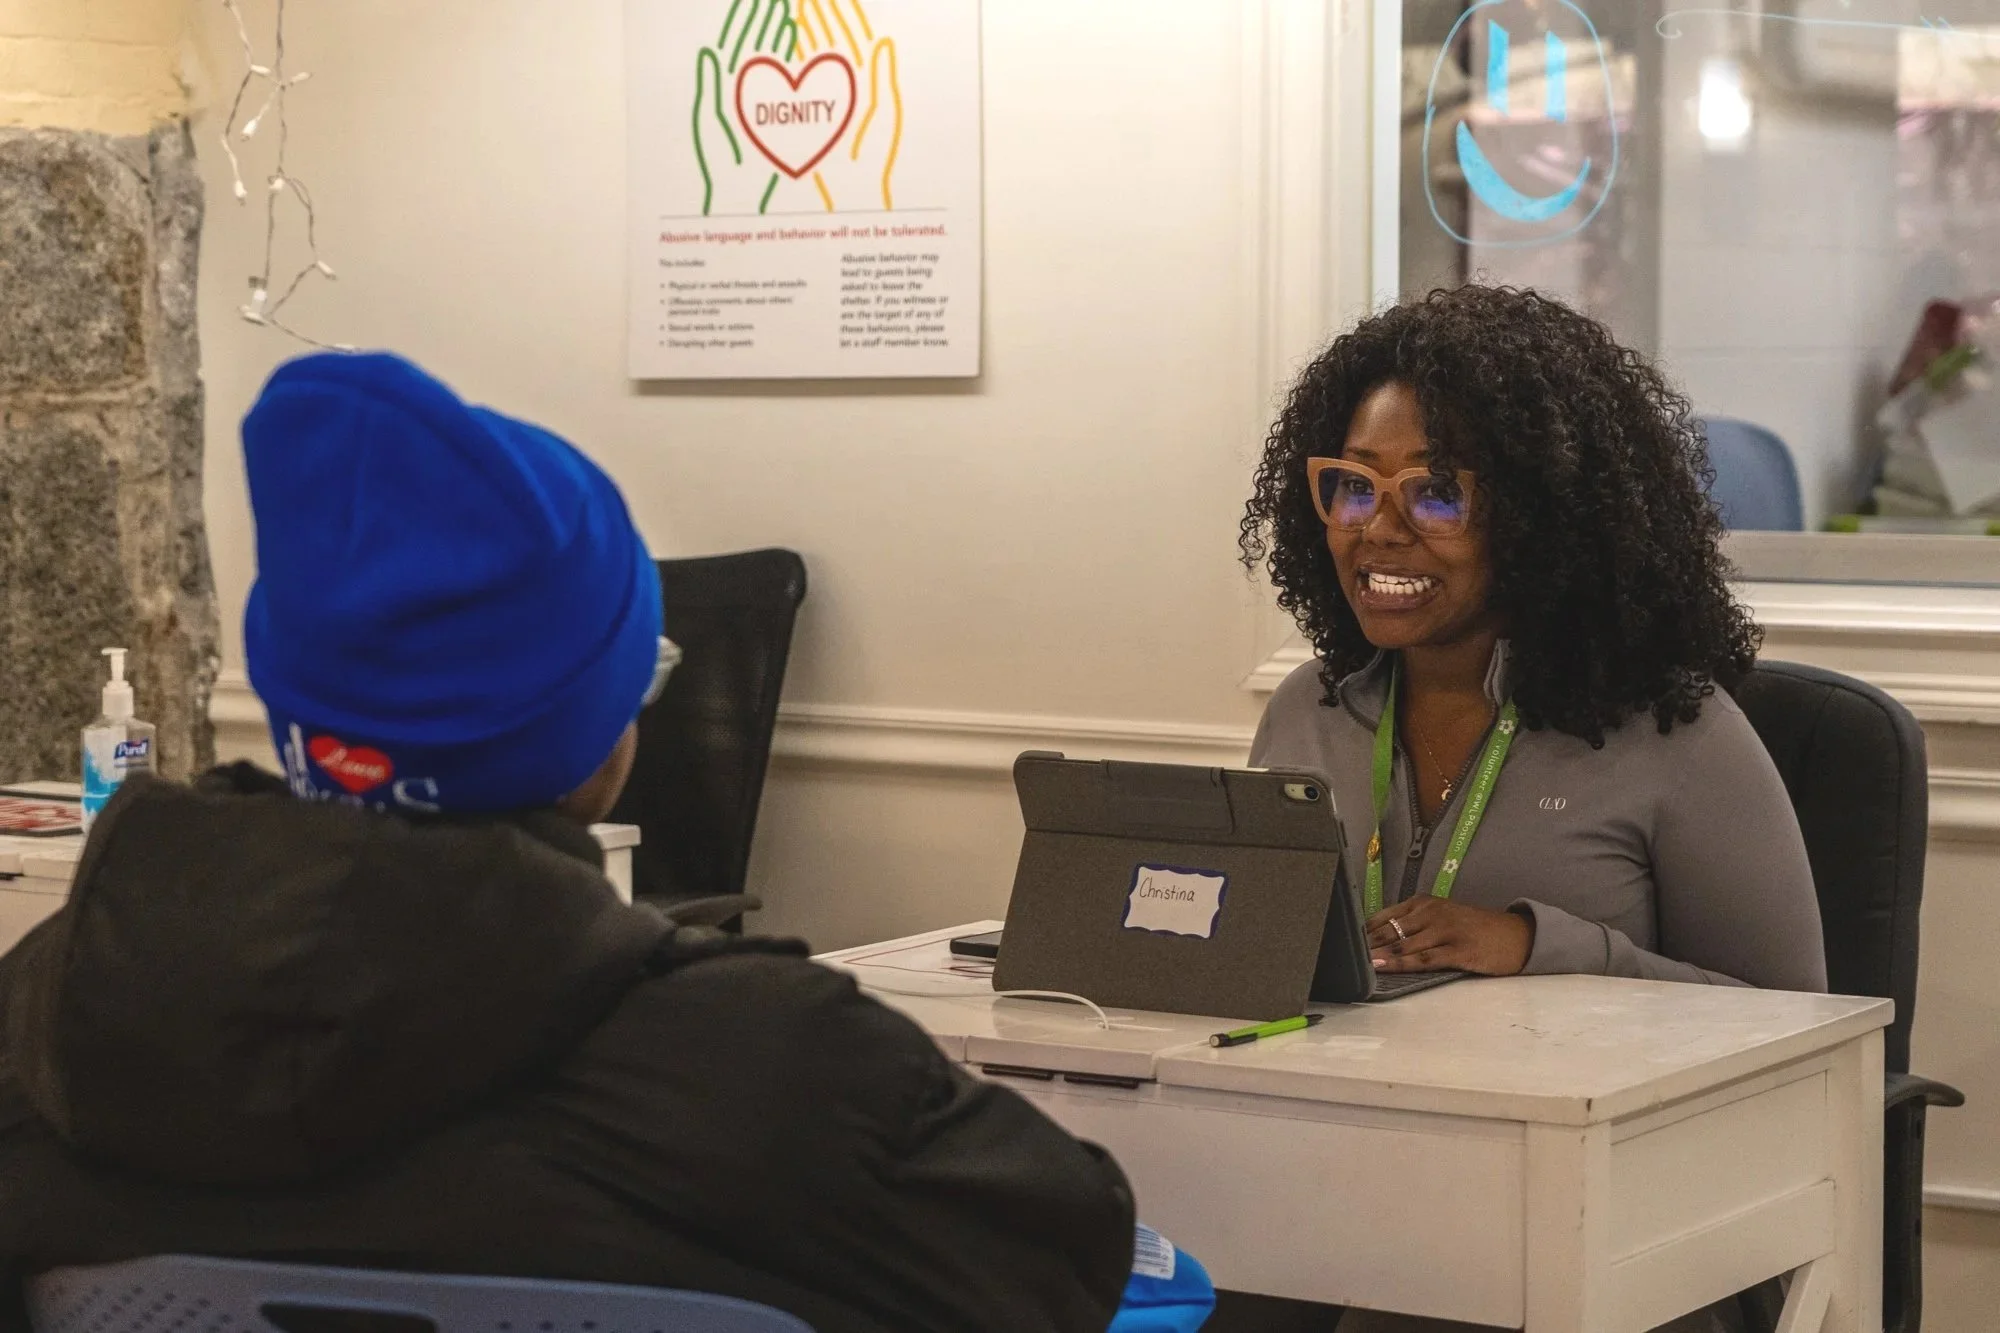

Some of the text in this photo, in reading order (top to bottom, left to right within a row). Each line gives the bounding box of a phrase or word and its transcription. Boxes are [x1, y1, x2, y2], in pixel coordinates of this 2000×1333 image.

[756, 100, 836, 125] DIGNITY
[660, 224, 948, 244] Abusive language and behavior will not be tolerated.
[842, 253, 939, 264] Abusive behavior may
[863, 268, 871, 277] to
[875, 269, 903, 279] guests
[906, 267, 932, 278] being
[841, 281, 922, 291] asked to leave the
[884, 297, 900, 307] you
[903, 296, 936, 304] witness
[938, 296, 949, 304] or
[841, 308, 945, 320] are the target of any of
[840, 324, 863, 333] these
[915, 324, 945, 334] please
[1480, 744, 1502, 791] volunteer
[1139, 876, 1195, 902] Christina
